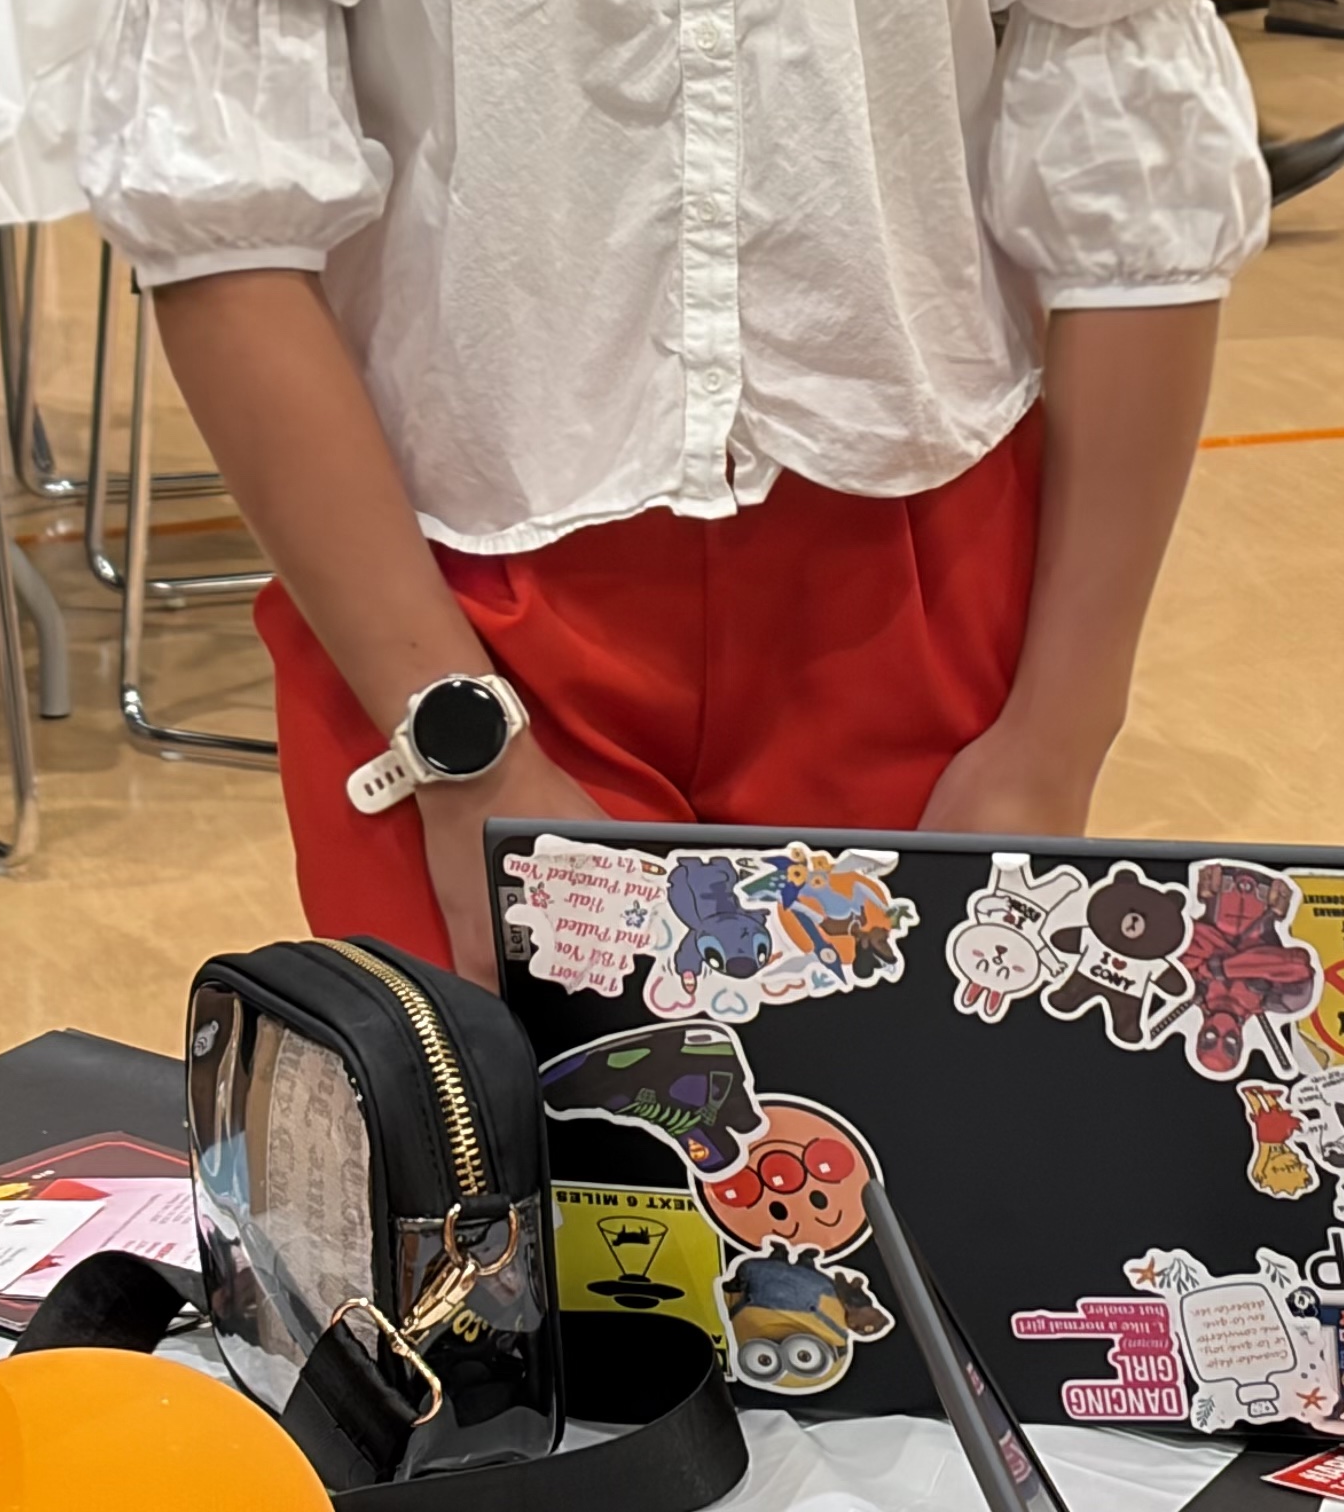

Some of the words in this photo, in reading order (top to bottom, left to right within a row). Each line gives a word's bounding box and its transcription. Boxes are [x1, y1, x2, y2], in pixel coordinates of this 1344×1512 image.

[508, 859, 543, 881] You
[546, 866, 621, 895] Punched
[624, 882, 661, 902] And
[564, 893, 605, 915] Hair
[506, 893, 524, 954] Leno
[556, 918, 611, 943] Pulled
[615, 930, 651, 949] And
[1089, 965, 1136, 992] CONY
[555, 1191, 618, 1206] MILES
[626, 1195, 638, 1207] 6
[646, 1196, 699, 1212] NEXT
[1084, 1303, 1136, 1316] cooler.
[1140, 1304, 1165, 1315] but
[1019, 1317, 1046, 1333] girl
[1049, 1320, 1105, 1333] normal
[1121, 1321, 1149, 1334] like
[1116, 1354, 1173, 1382] GIRL
[1069, 1387, 1179, 1414] DANCING
